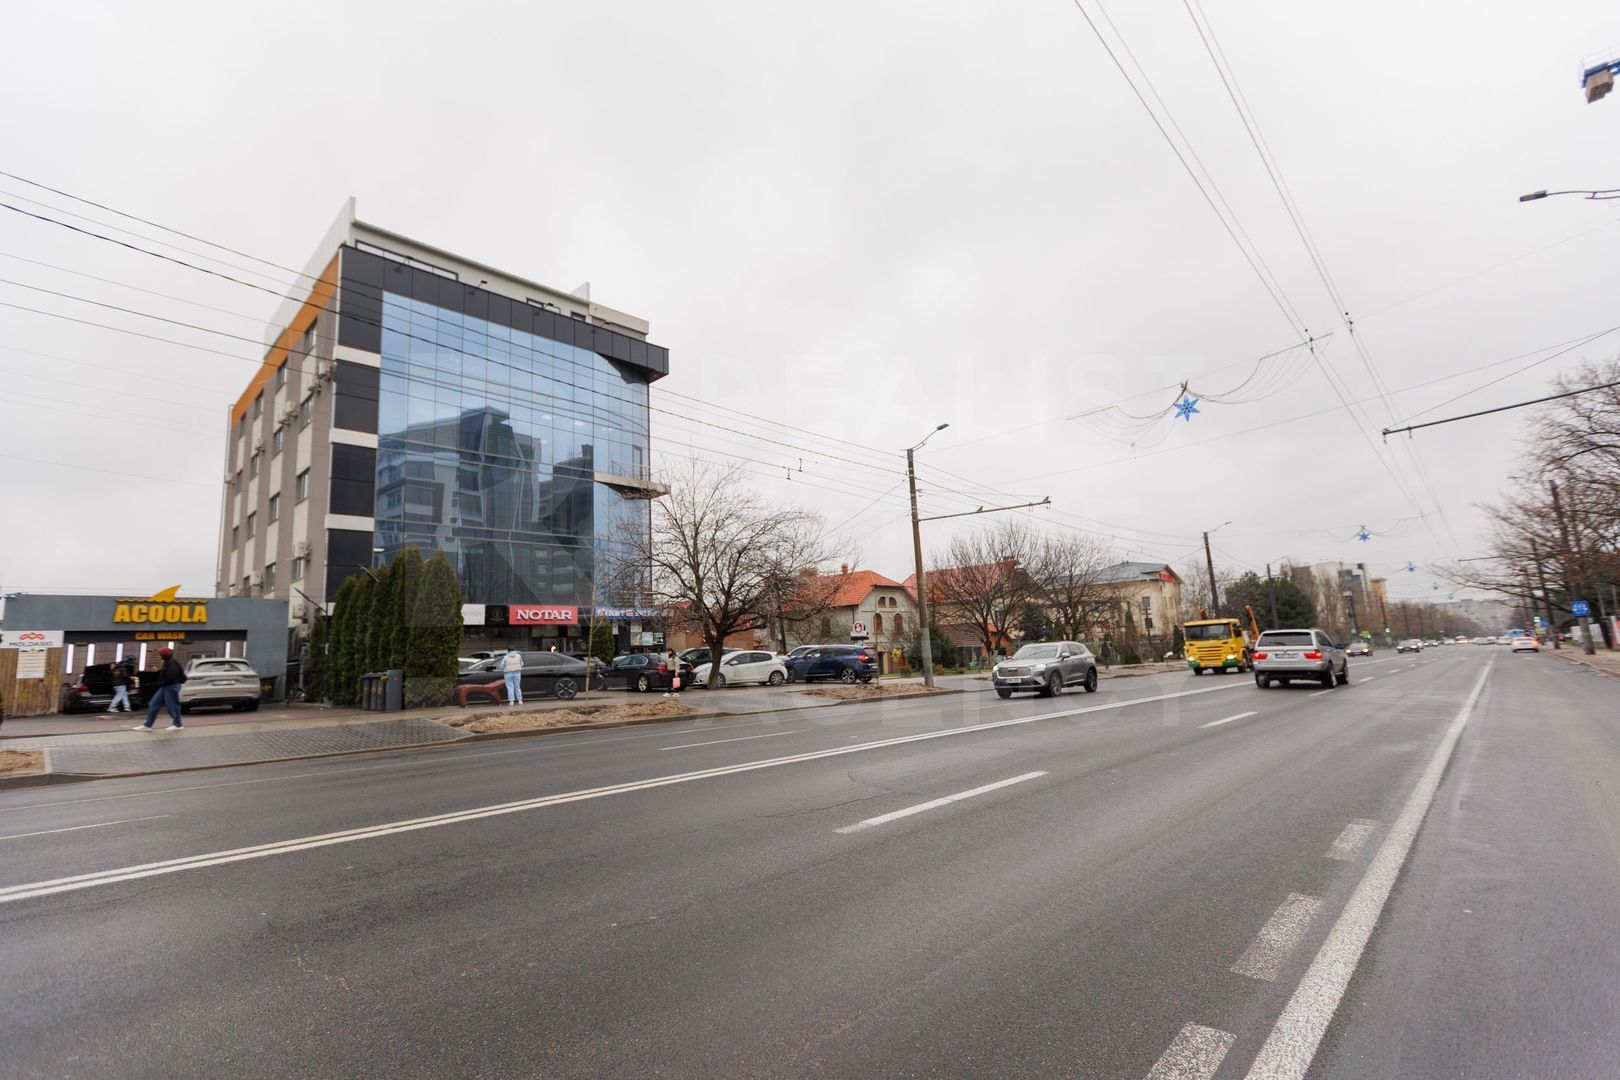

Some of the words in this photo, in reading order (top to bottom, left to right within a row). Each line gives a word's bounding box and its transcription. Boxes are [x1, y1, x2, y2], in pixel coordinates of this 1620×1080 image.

[113, 604, 208, 623] ACOOLA
[516, 609, 573, 620] NOTAR
[135, 631, 155, 640] CAR
[157, 631, 185, 640] WASH
